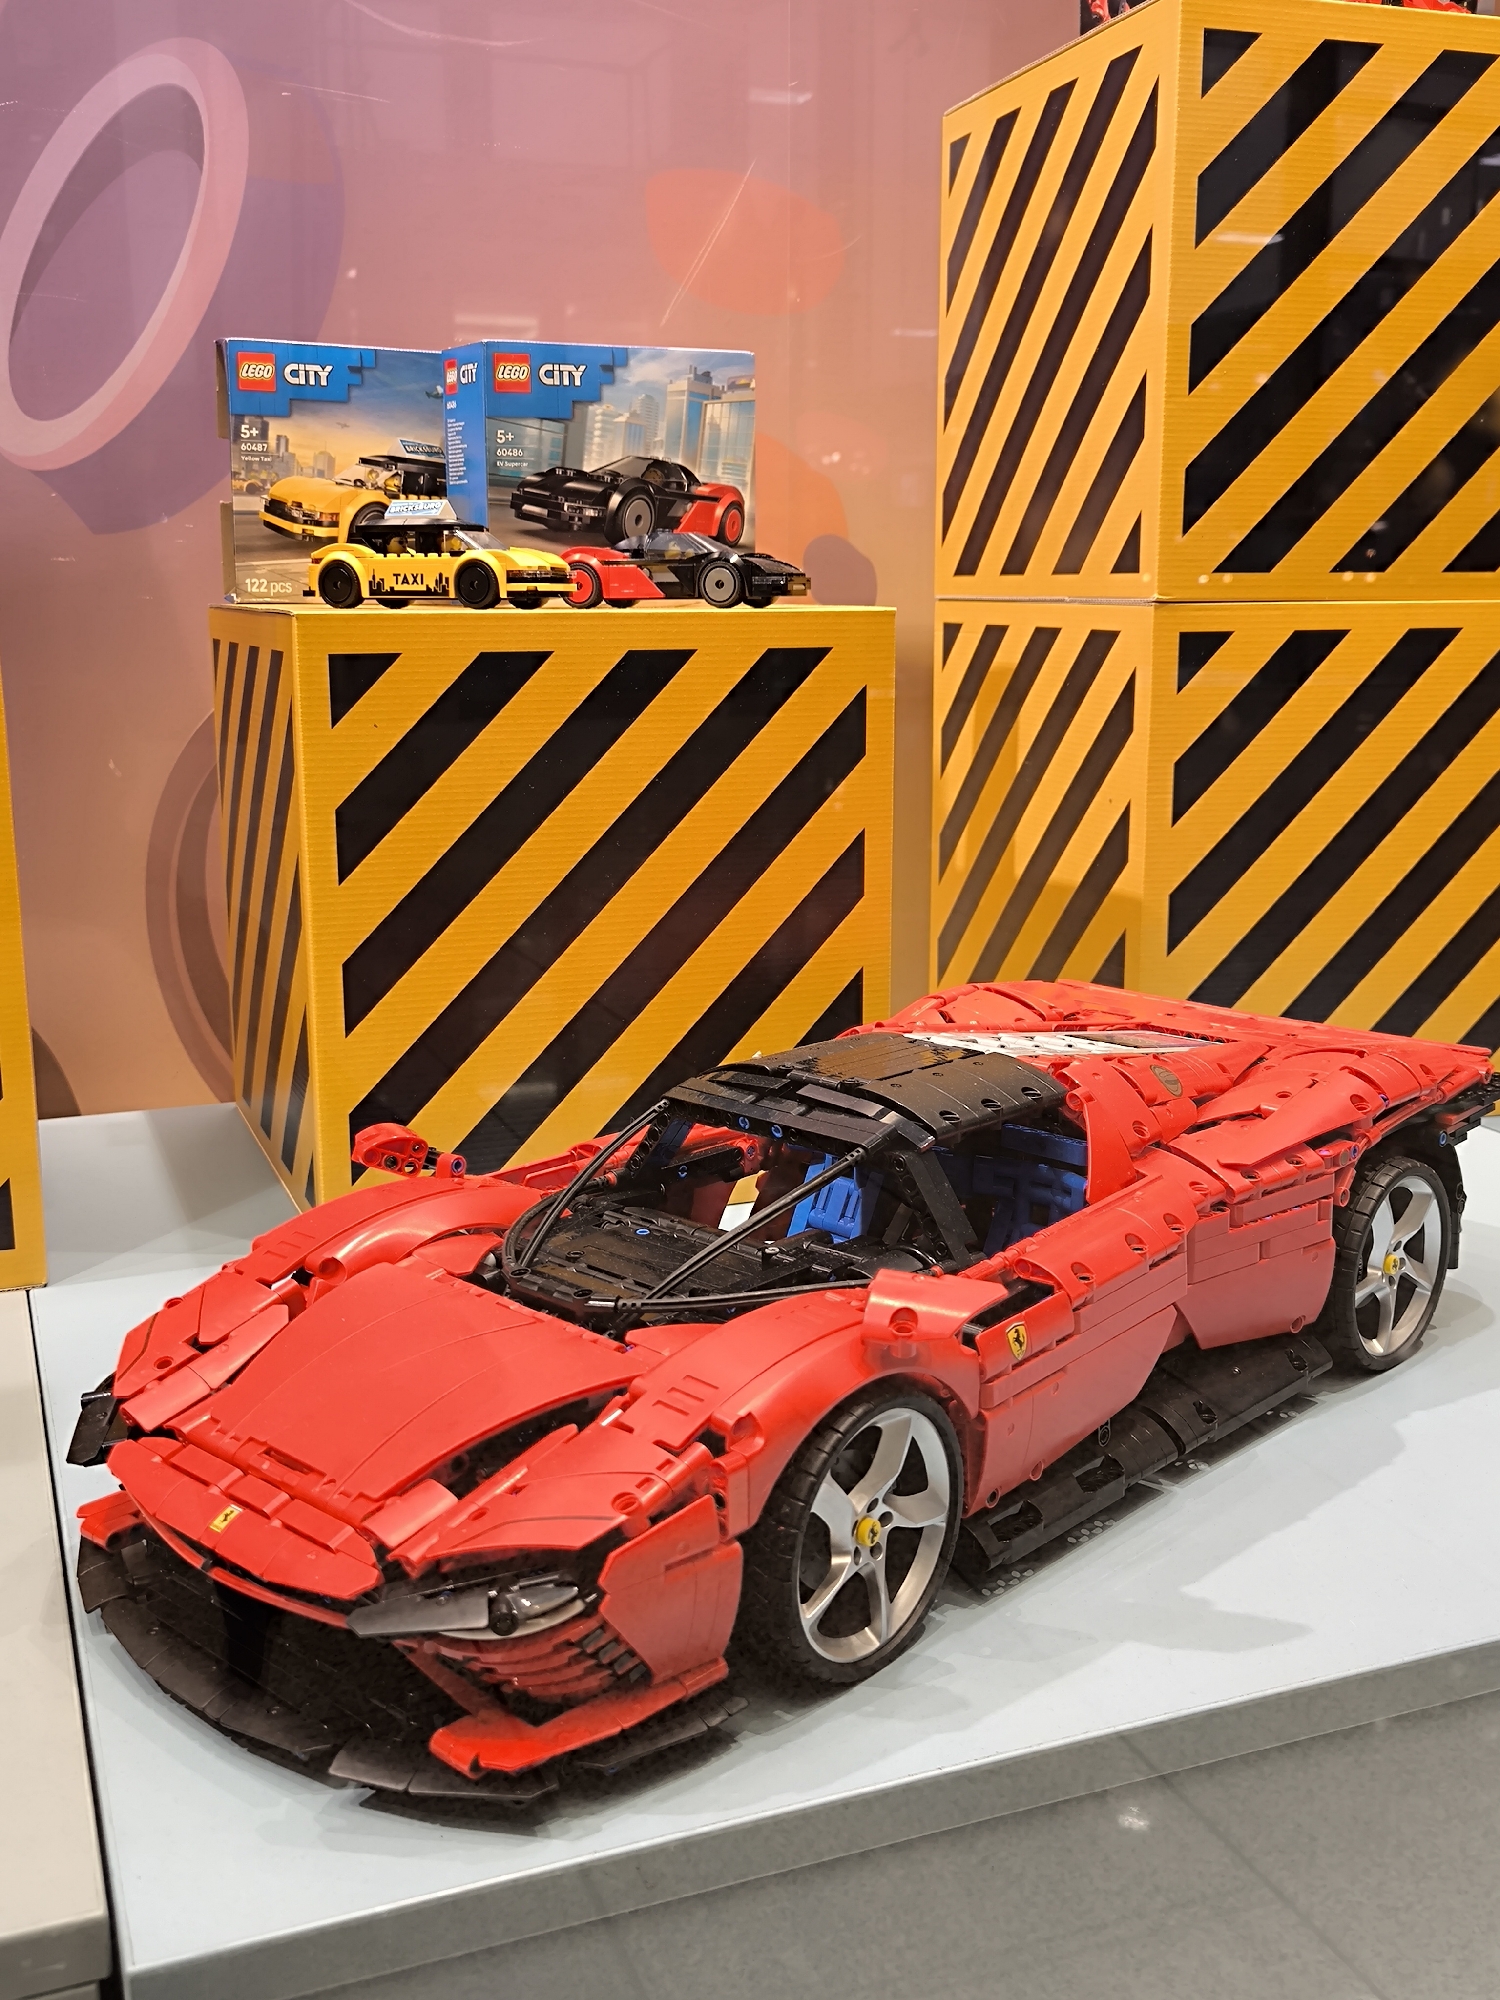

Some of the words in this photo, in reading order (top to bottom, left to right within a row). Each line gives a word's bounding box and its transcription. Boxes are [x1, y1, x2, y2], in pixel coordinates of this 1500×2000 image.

[240, 363, 275, 380] LEGO
[283, 362, 334, 387] CITY
[460, 362, 479, 385] CITY
[496, 363, 531, 381] LEGO
[538, 362, 587, 387] CITY
[240, 424, 259, 439] 5+
[496, 429, 515, 444] 5+
[240, 443, 268, 452] 60487
[496, 448, 523, 457] 60486
[393, 573, 424, 585] TAXI
[245, 578, 268, 593] 122
[270, 581, 293, 596] pcs
